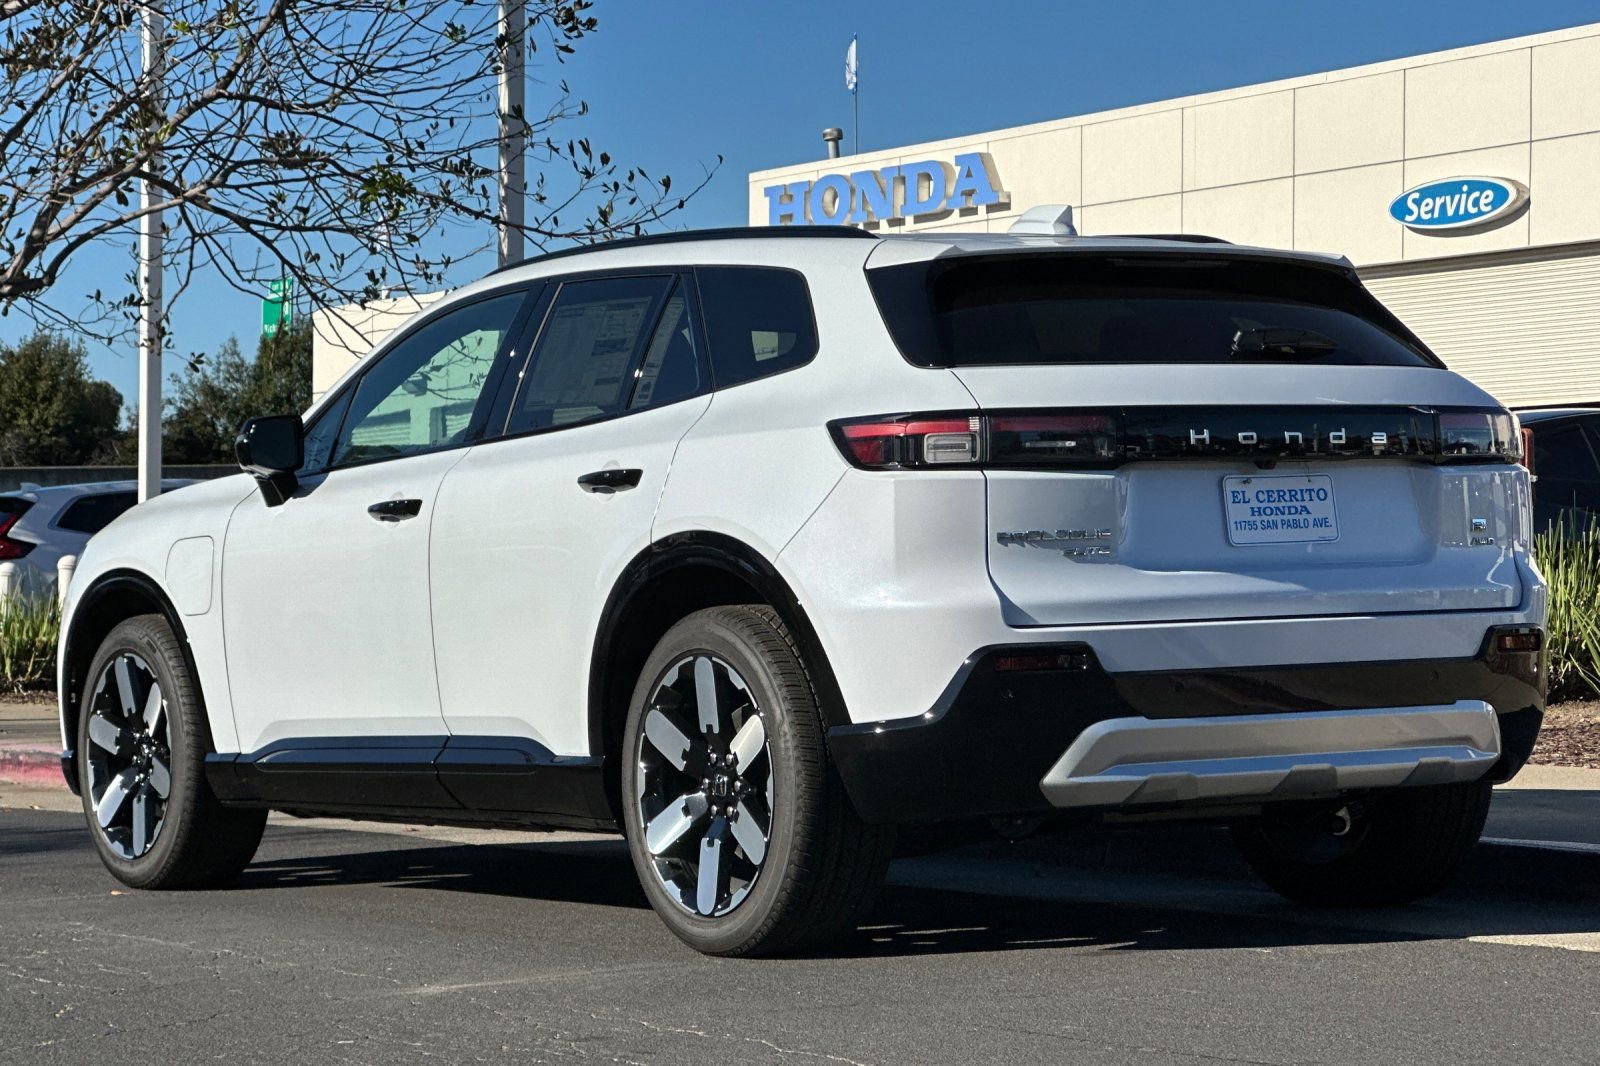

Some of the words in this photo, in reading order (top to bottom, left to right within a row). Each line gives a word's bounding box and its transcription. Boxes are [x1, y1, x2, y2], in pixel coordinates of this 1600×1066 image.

[764, 152, 1001, 226] HONDA
[1404, 184, 1494, 222] Service
[1189, 427, 1388, 445] Honda
[1231, 490, 1250, 504] EL
[1255, 487, 1328, 504] CERRITO
[1250, 505, 1312, 517] HONDA
[1233, 520, 1258, 531] 11755
[1260, 519, 1278, 531] SAN
[1281, 518, 1309, 530] PABLO
[1312, 517, 1333, 528] AVE.
